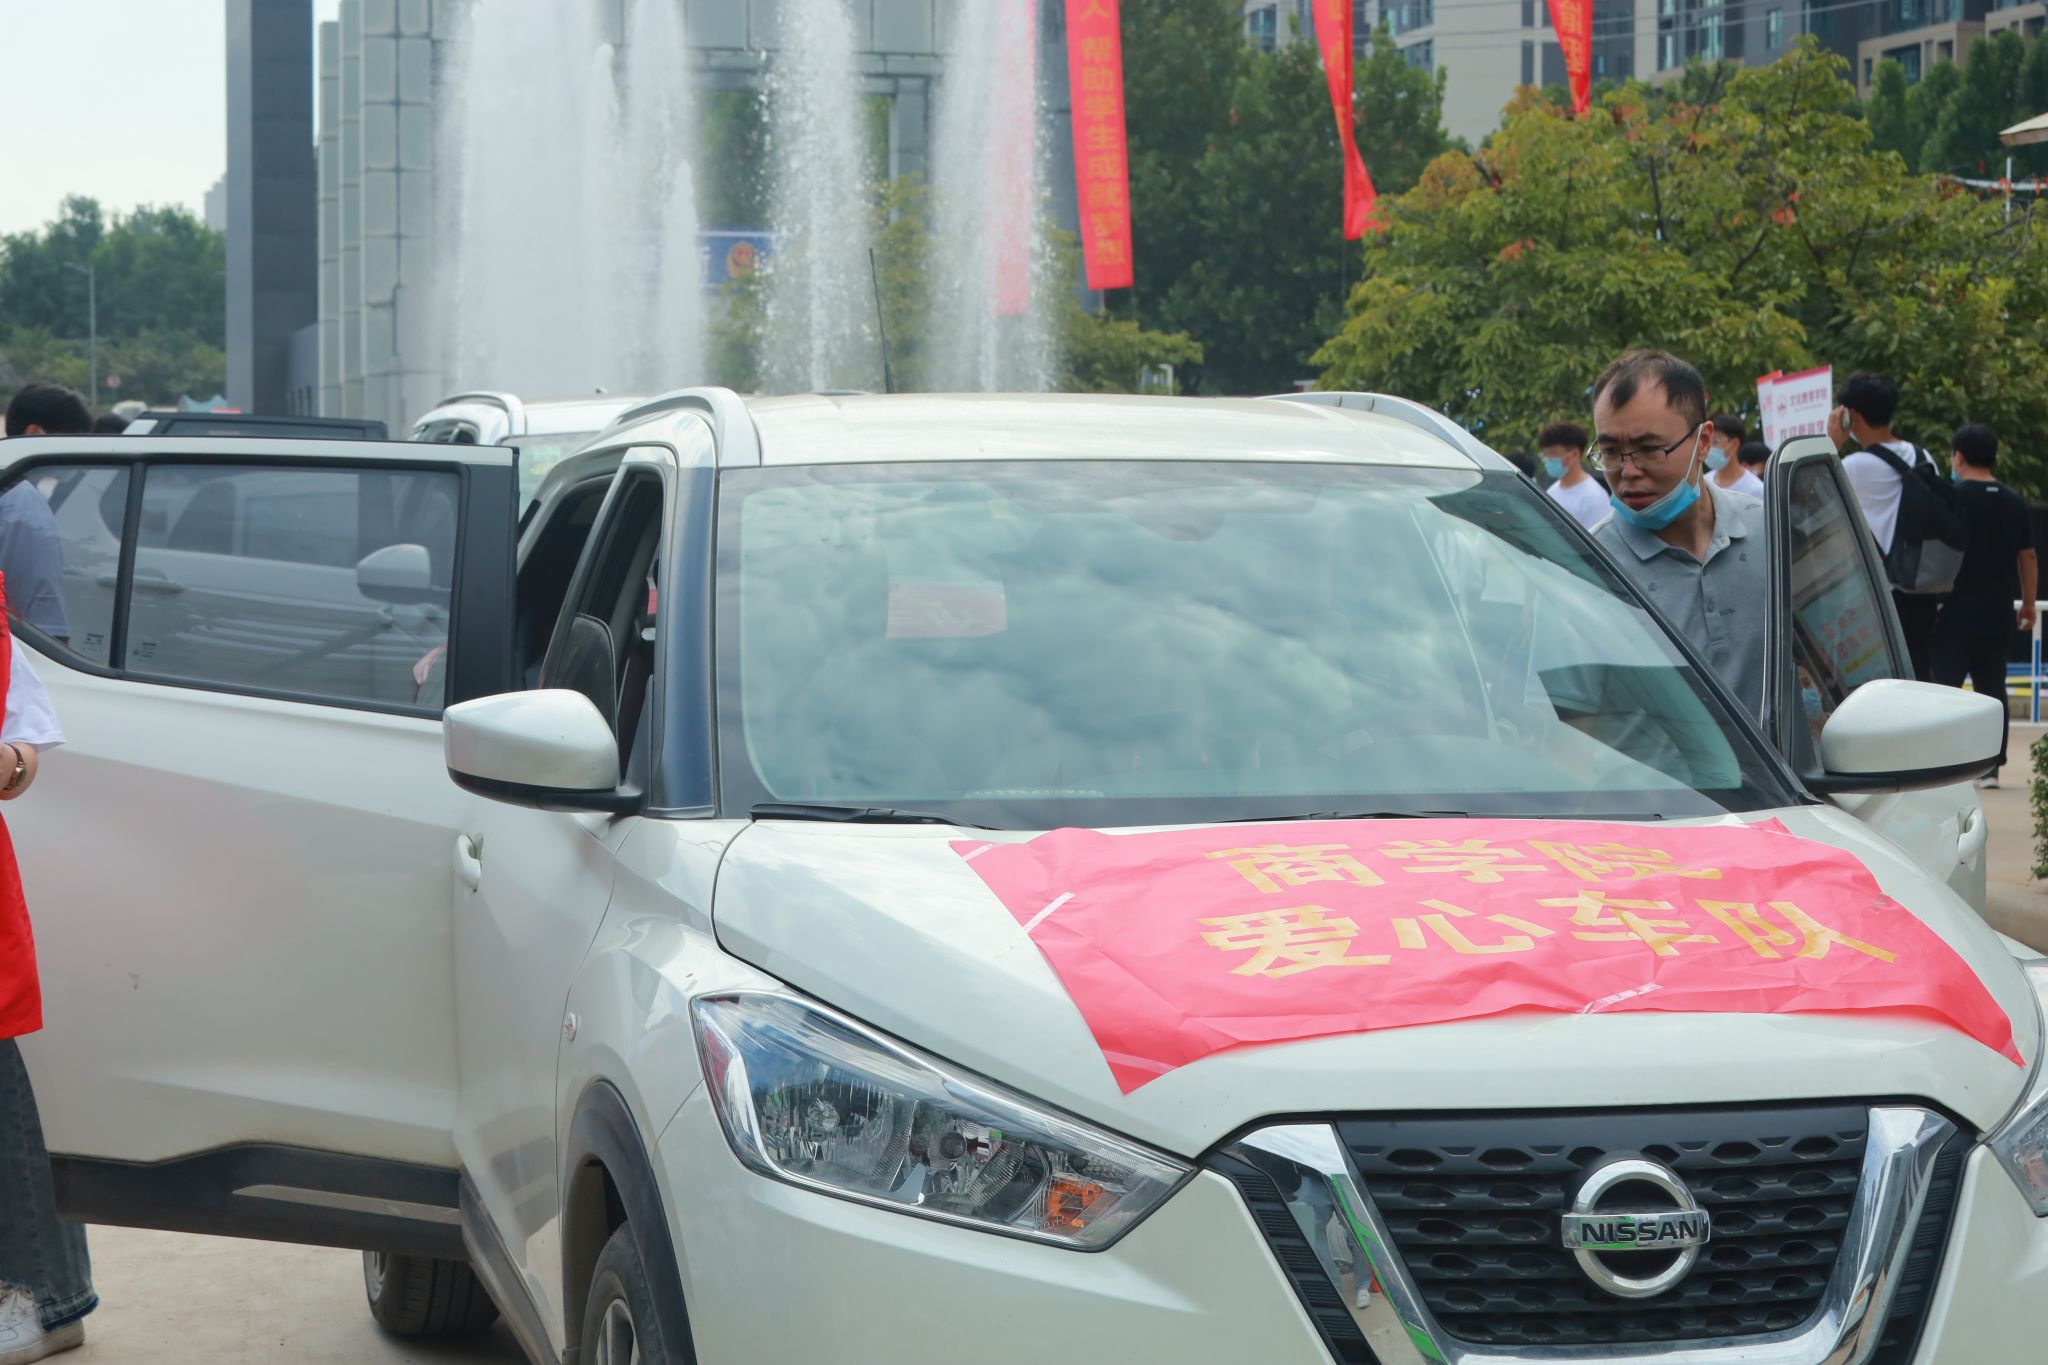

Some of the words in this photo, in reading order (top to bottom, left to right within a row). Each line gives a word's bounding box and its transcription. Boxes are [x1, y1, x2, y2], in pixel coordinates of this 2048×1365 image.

[1205, 838, 1722, 894] 商学院
[1196, 889, 1899, 979] 爱心车队
[1581, 1220, 1698, 1243] NISSAN
